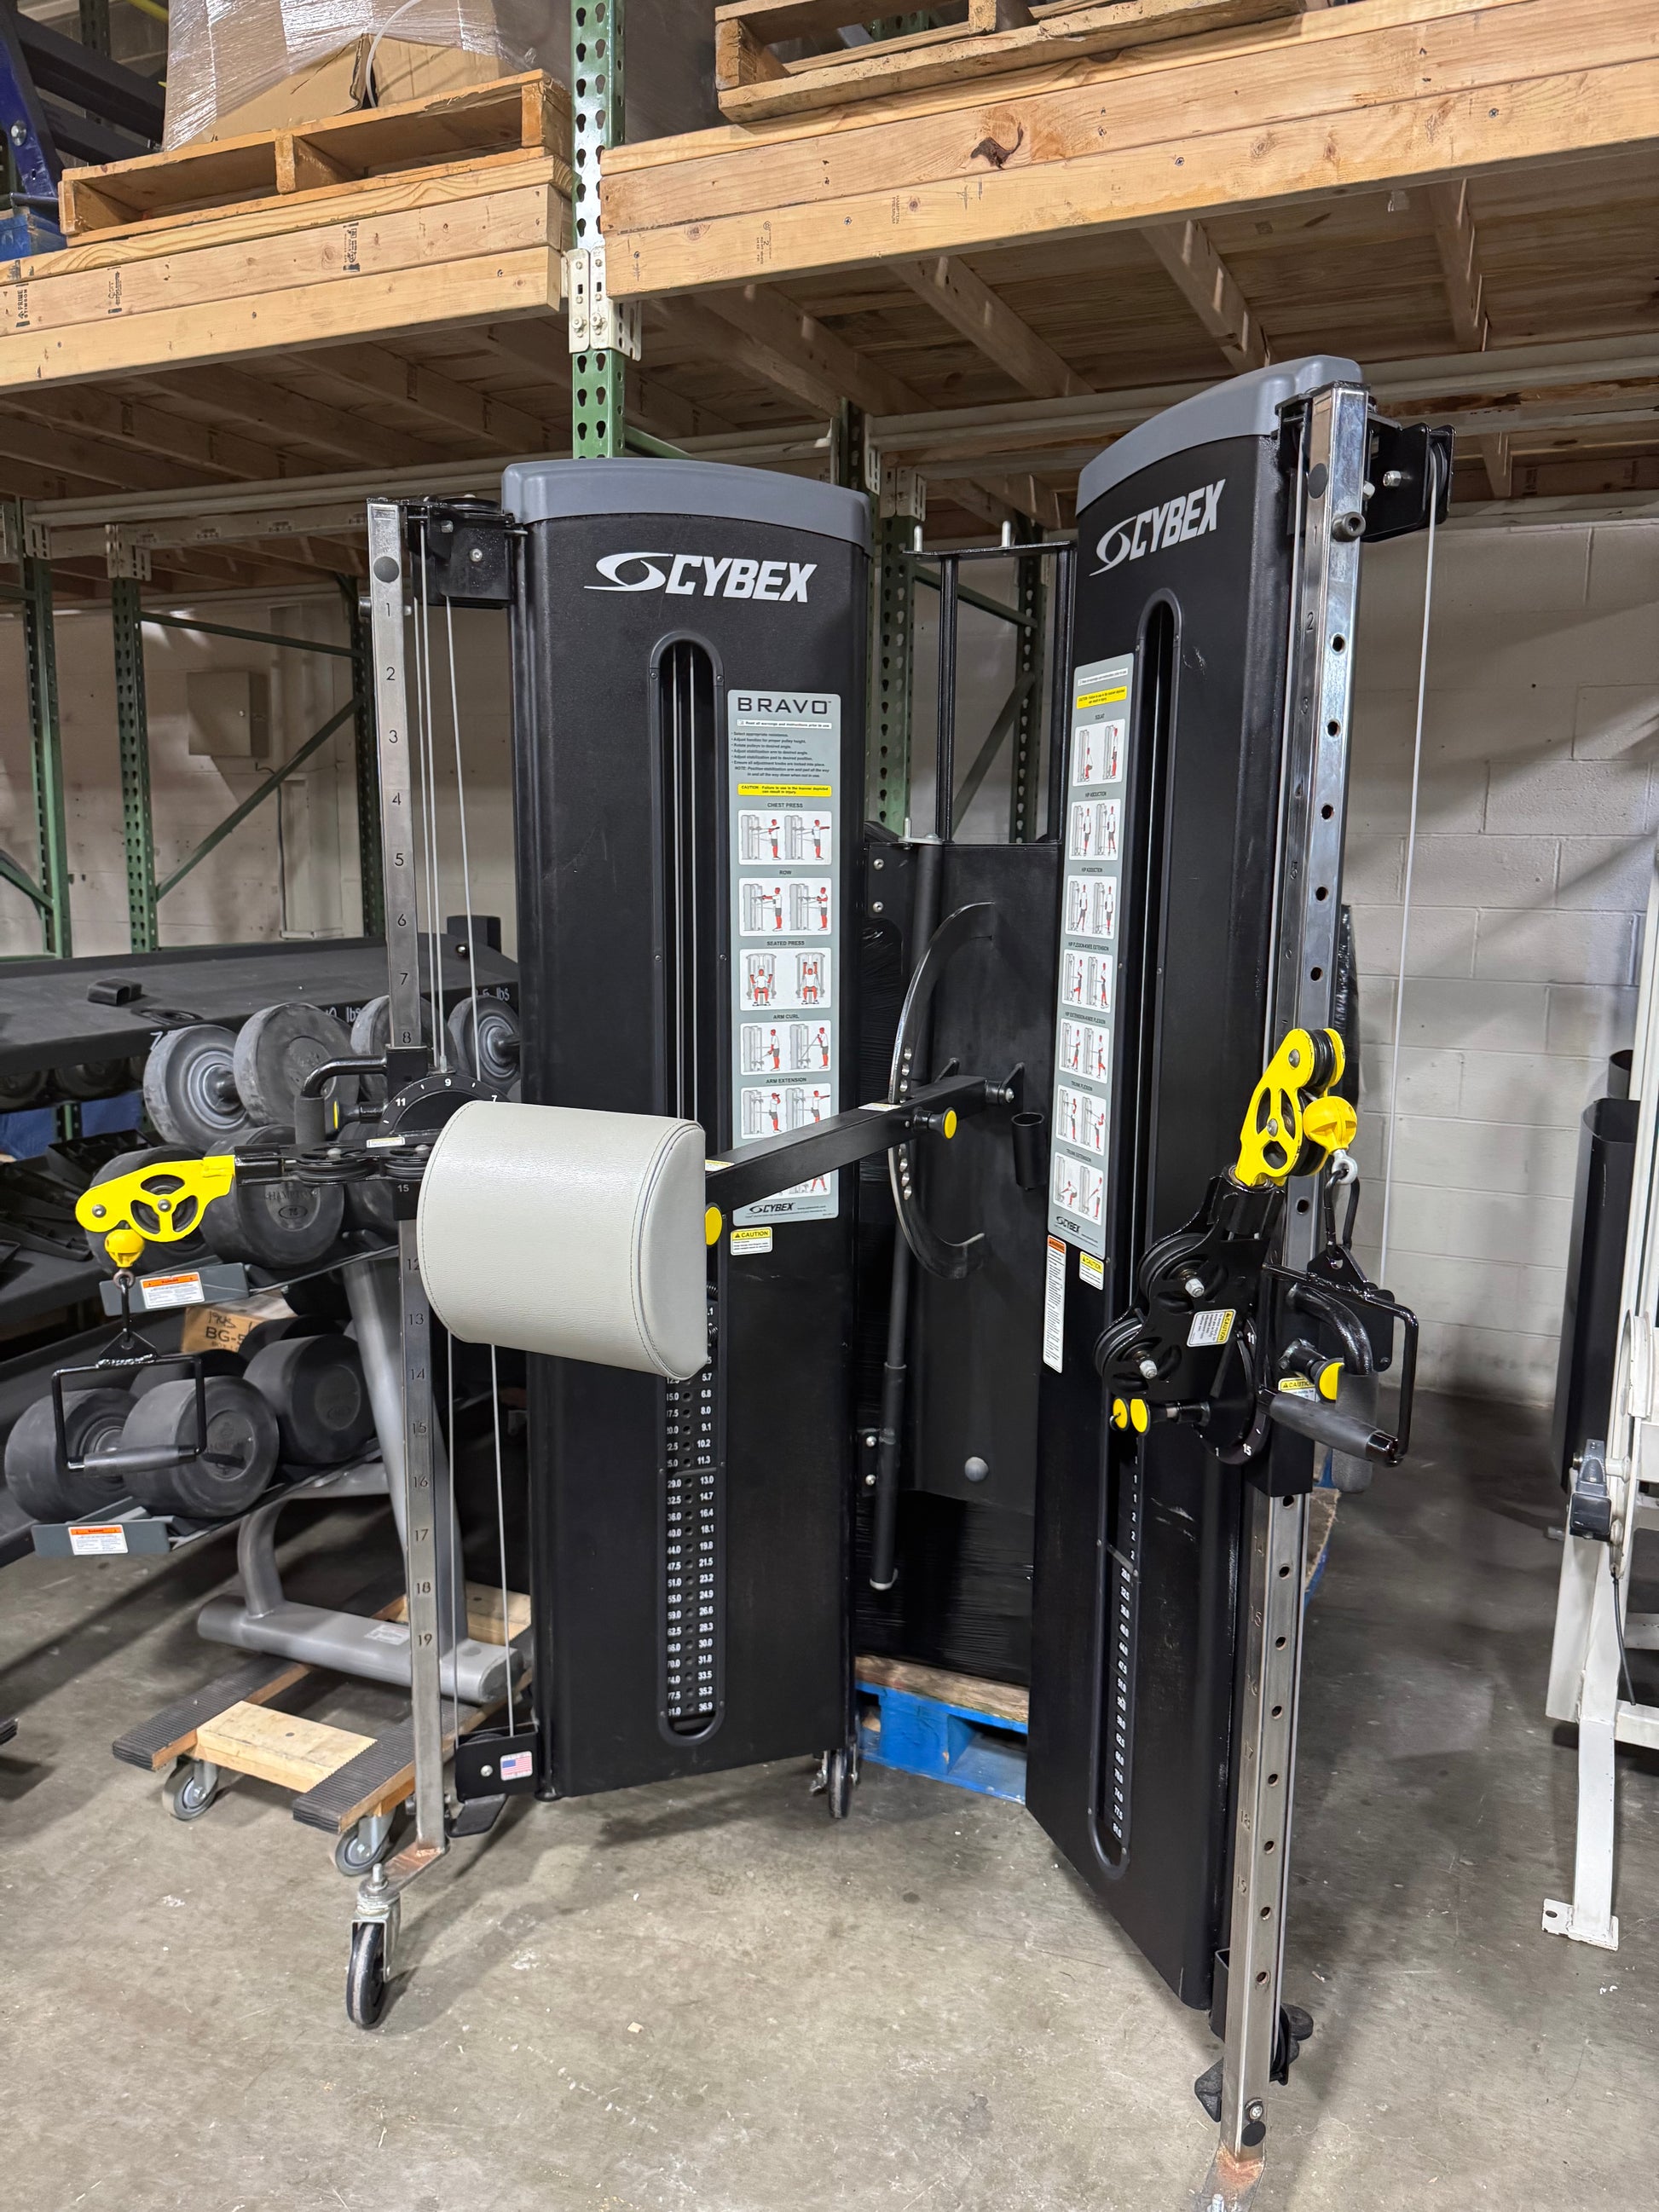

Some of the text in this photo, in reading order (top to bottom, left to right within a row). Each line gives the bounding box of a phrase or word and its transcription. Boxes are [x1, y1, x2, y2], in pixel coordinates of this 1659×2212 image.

[1130, 478, 1226, 559] CYBEX
[665, 555, 818, 604] CYBEX
[385, 603, 391, 617] 1
[386, 667, 396, 681] 2
[738, 697, 828, 715] BRAVO
[389, 730, 398, 743] 3
[392, 792, 402, 806] 4
[395, 852, 404, 867] 5
[397, 913, 407, 927] 6
[400, 973, 408, 985] 7
[402, 1031, 411, 1044] 8
[444, 1078, 452, 1087] 9
[395, 1097, 406, 1106] 11
[397, 1184, 410, 1193] 15
[763, 1202, 794, 1213] CYBEX
[406, 1258, 420, 1271] 12
[409, 1313, 424, 1325] 13
[1219, 1318, 1230, 1341] CAUTION
[1247, 1331, 1255, 1345] 11
[410, 1368, 425, 1381] 14
[702, 1373, 712, 1381] 5.7
[701, 1389, 711, 1398] 6.8
[700, 1406, 711, 1415] 8.0
[412, 1422, 427, 1435] 15
[701, 1422, 711, 1432] 9.1
[697, 1438, 711, 1448] 10.2
[1242, 1443, 1252, 1457] 15
[697, 1455, 711, 1465] 11.3
[413, 1476, 428, 1488] 16
[668, 1476, 714, 1488] 29.0 13.0
[668, 1492, 714, 1505] 32.5 14.7
[700, 1508, 714, 1518] 16.4
[414, 1528, 429, 1542] 17
[701, 1525, 714, 1534] 18.1
[699, 1541, 713, 1551] 19.8
[699, 1557, 713, 1567] 21.5
[668, 1574, 714, 1587] 51.0 23.2
[416, 1581, 431, 1595] 18
[699, 1590, 714, 1600] 24.9
[699, 1606, 713, 1616] 26.6
[699, 1622, 713, 1632] 28.3
[418, 1633, 433, 1646] 19
[699, 1638, 713, 1649] 30.0
[698, 1654, 712, 1664] 31.8
[698, 1671, 712, 1681] 33.5
[699, 1686, 713, 1696] 35.2
[699, 1702, 713, 1712] 36.9
